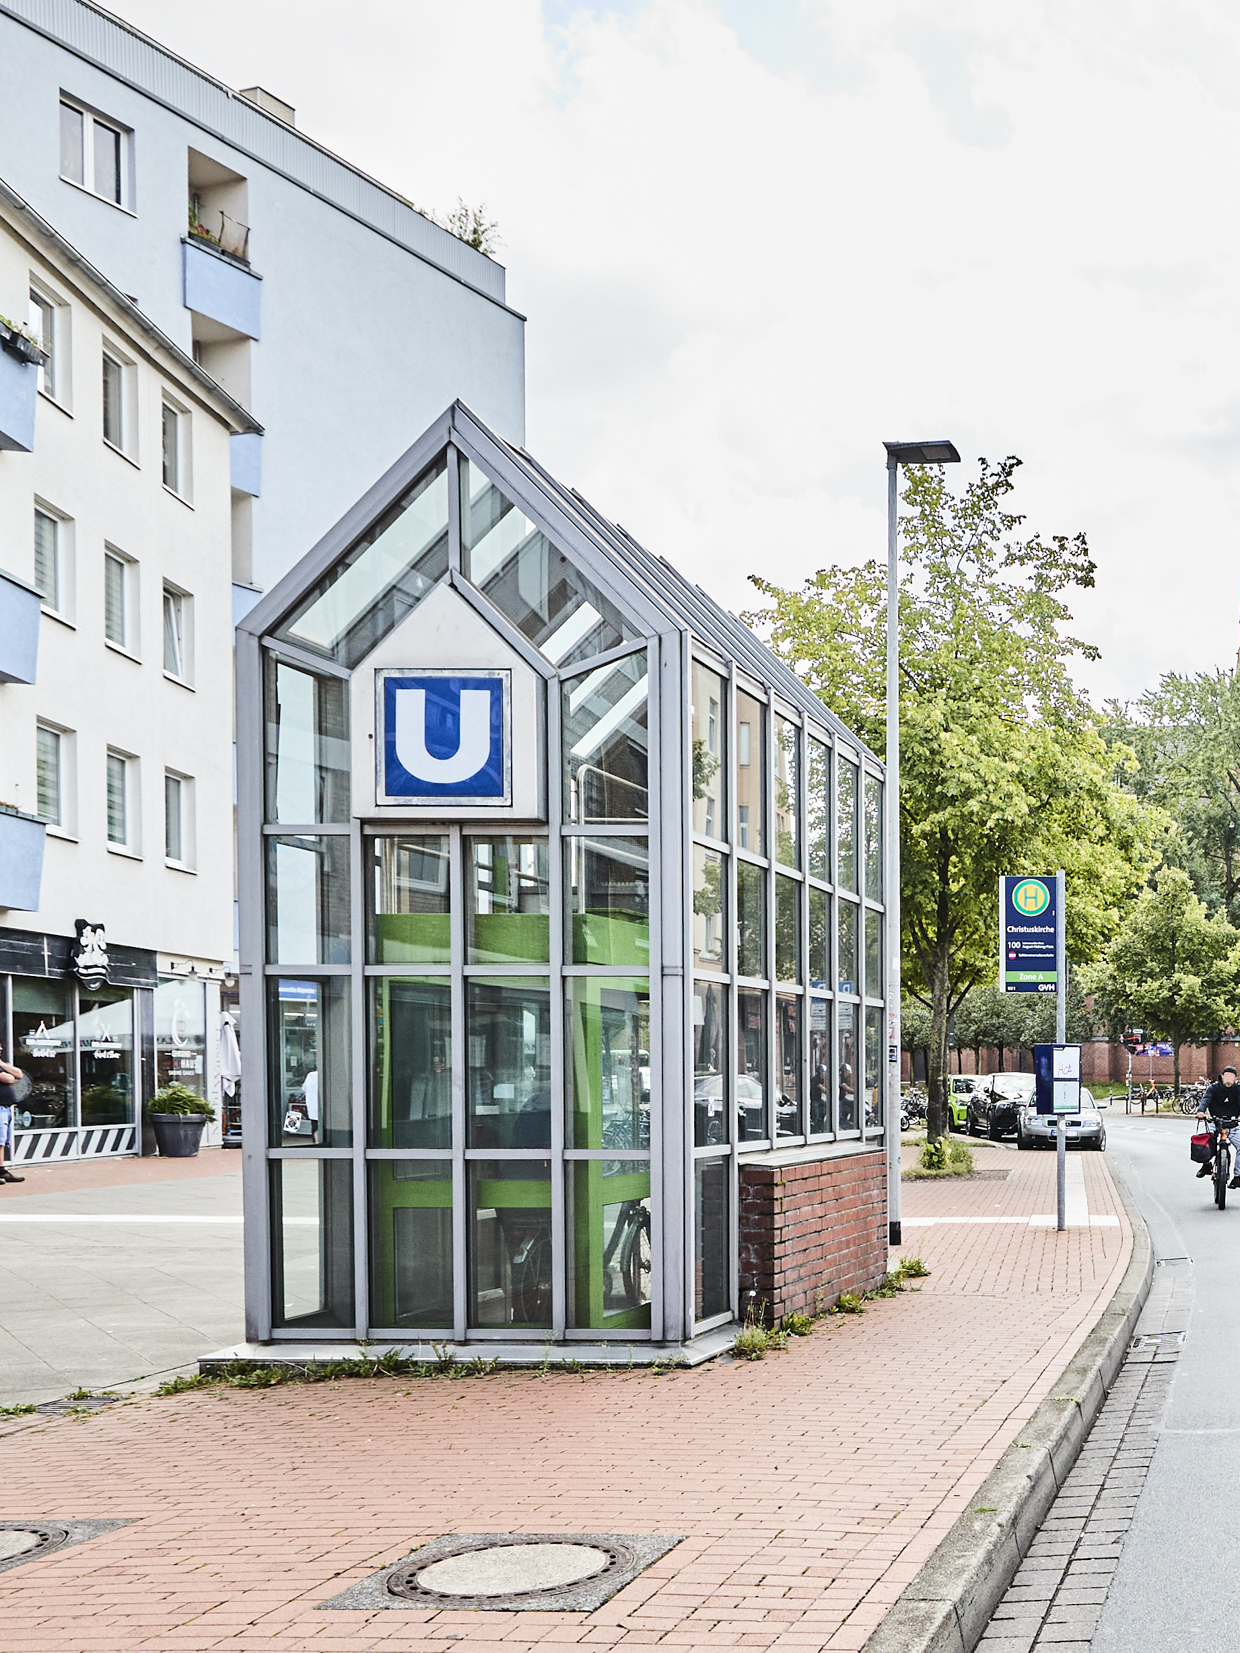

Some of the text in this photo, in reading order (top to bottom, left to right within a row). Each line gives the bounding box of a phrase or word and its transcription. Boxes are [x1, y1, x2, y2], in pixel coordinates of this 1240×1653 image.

[396, 689, 490, 784] U
[1024, 888, 1038, 907] H
[1008, 941, 1021, 949] 100
[1019, 973, 1044, 981] Zone A
